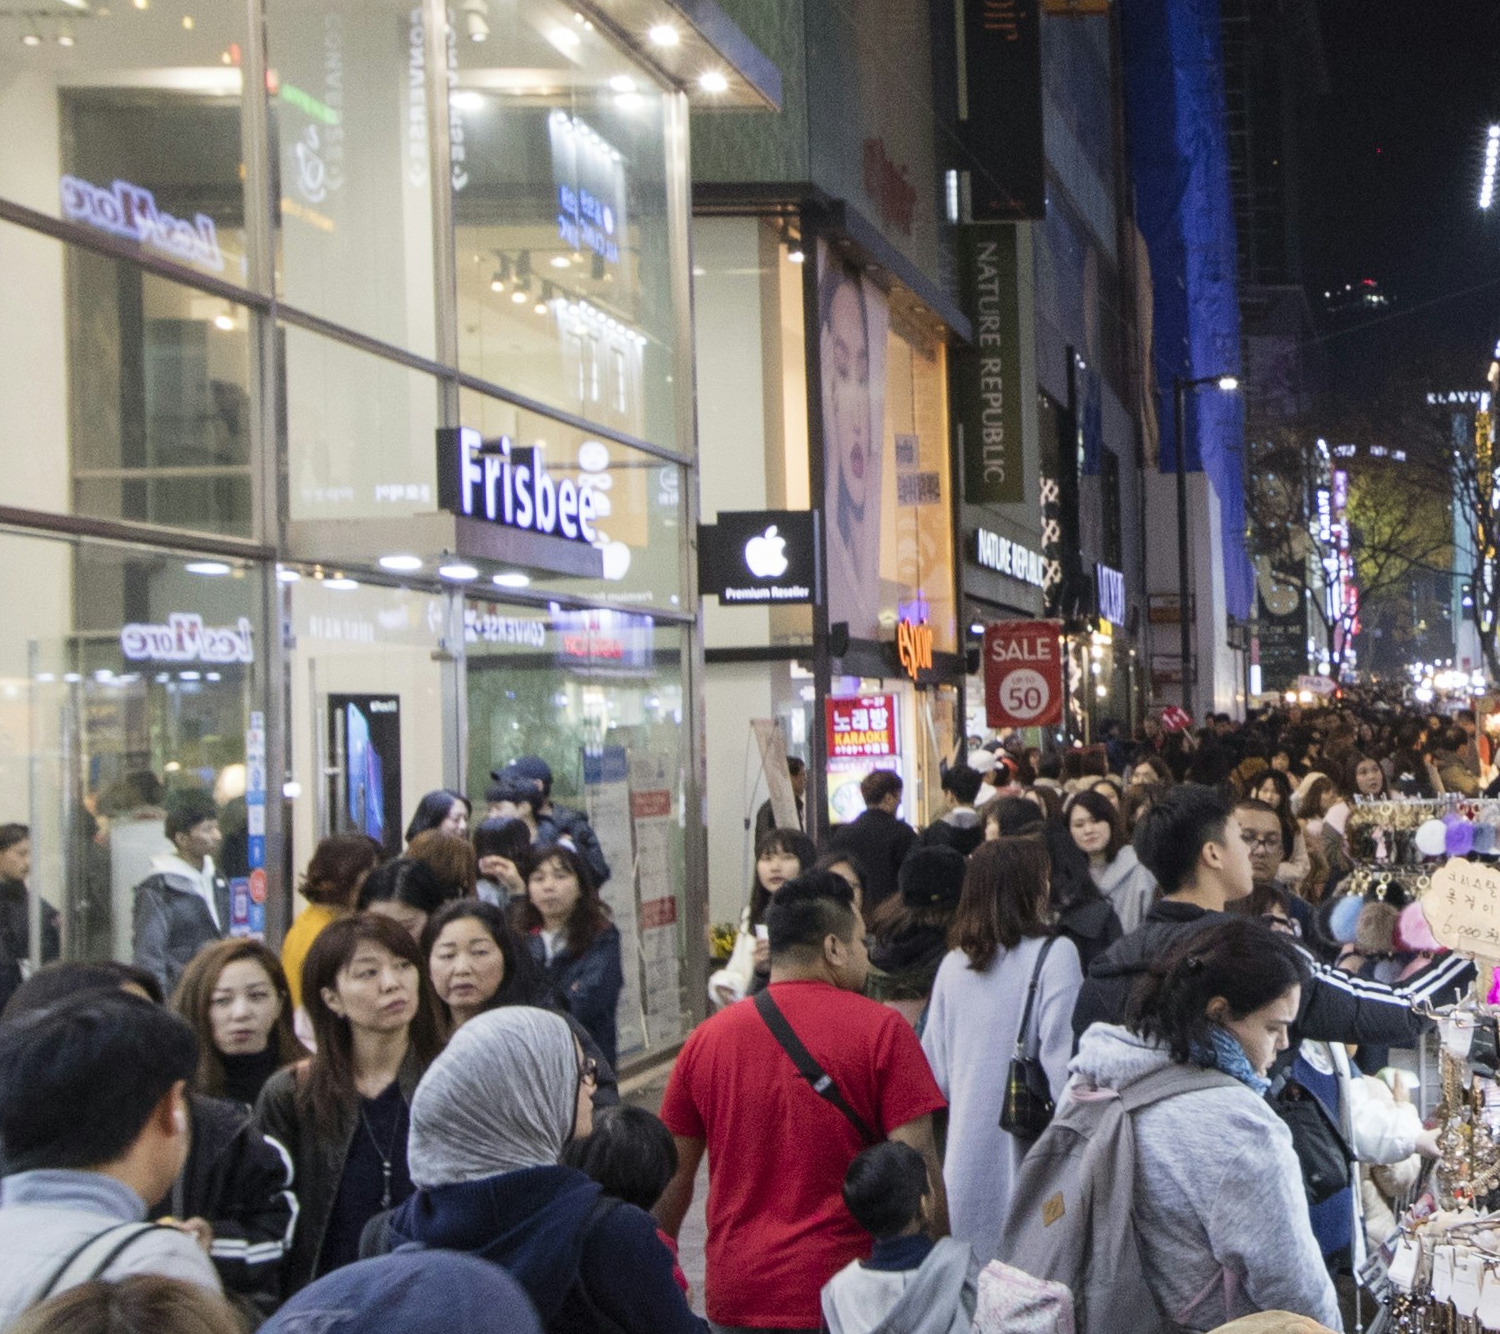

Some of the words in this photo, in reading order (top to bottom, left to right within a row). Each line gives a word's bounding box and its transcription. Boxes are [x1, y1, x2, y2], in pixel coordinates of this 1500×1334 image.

[975, 242, 1002, 355] NATURE
[979, 361, 1005, 485] REPUBLIC
[459, 425, 598, 543] Frisbee
[725, 586, 768, 601] Premium
[771, 586, 809, 601] Reseller
[991, 637, 1052, 662] SALE
[1008, 686, 1043, 711] 50
[833, 707, 888, 732] 노래방
[834, 731, 889, 745] KARAOKE
